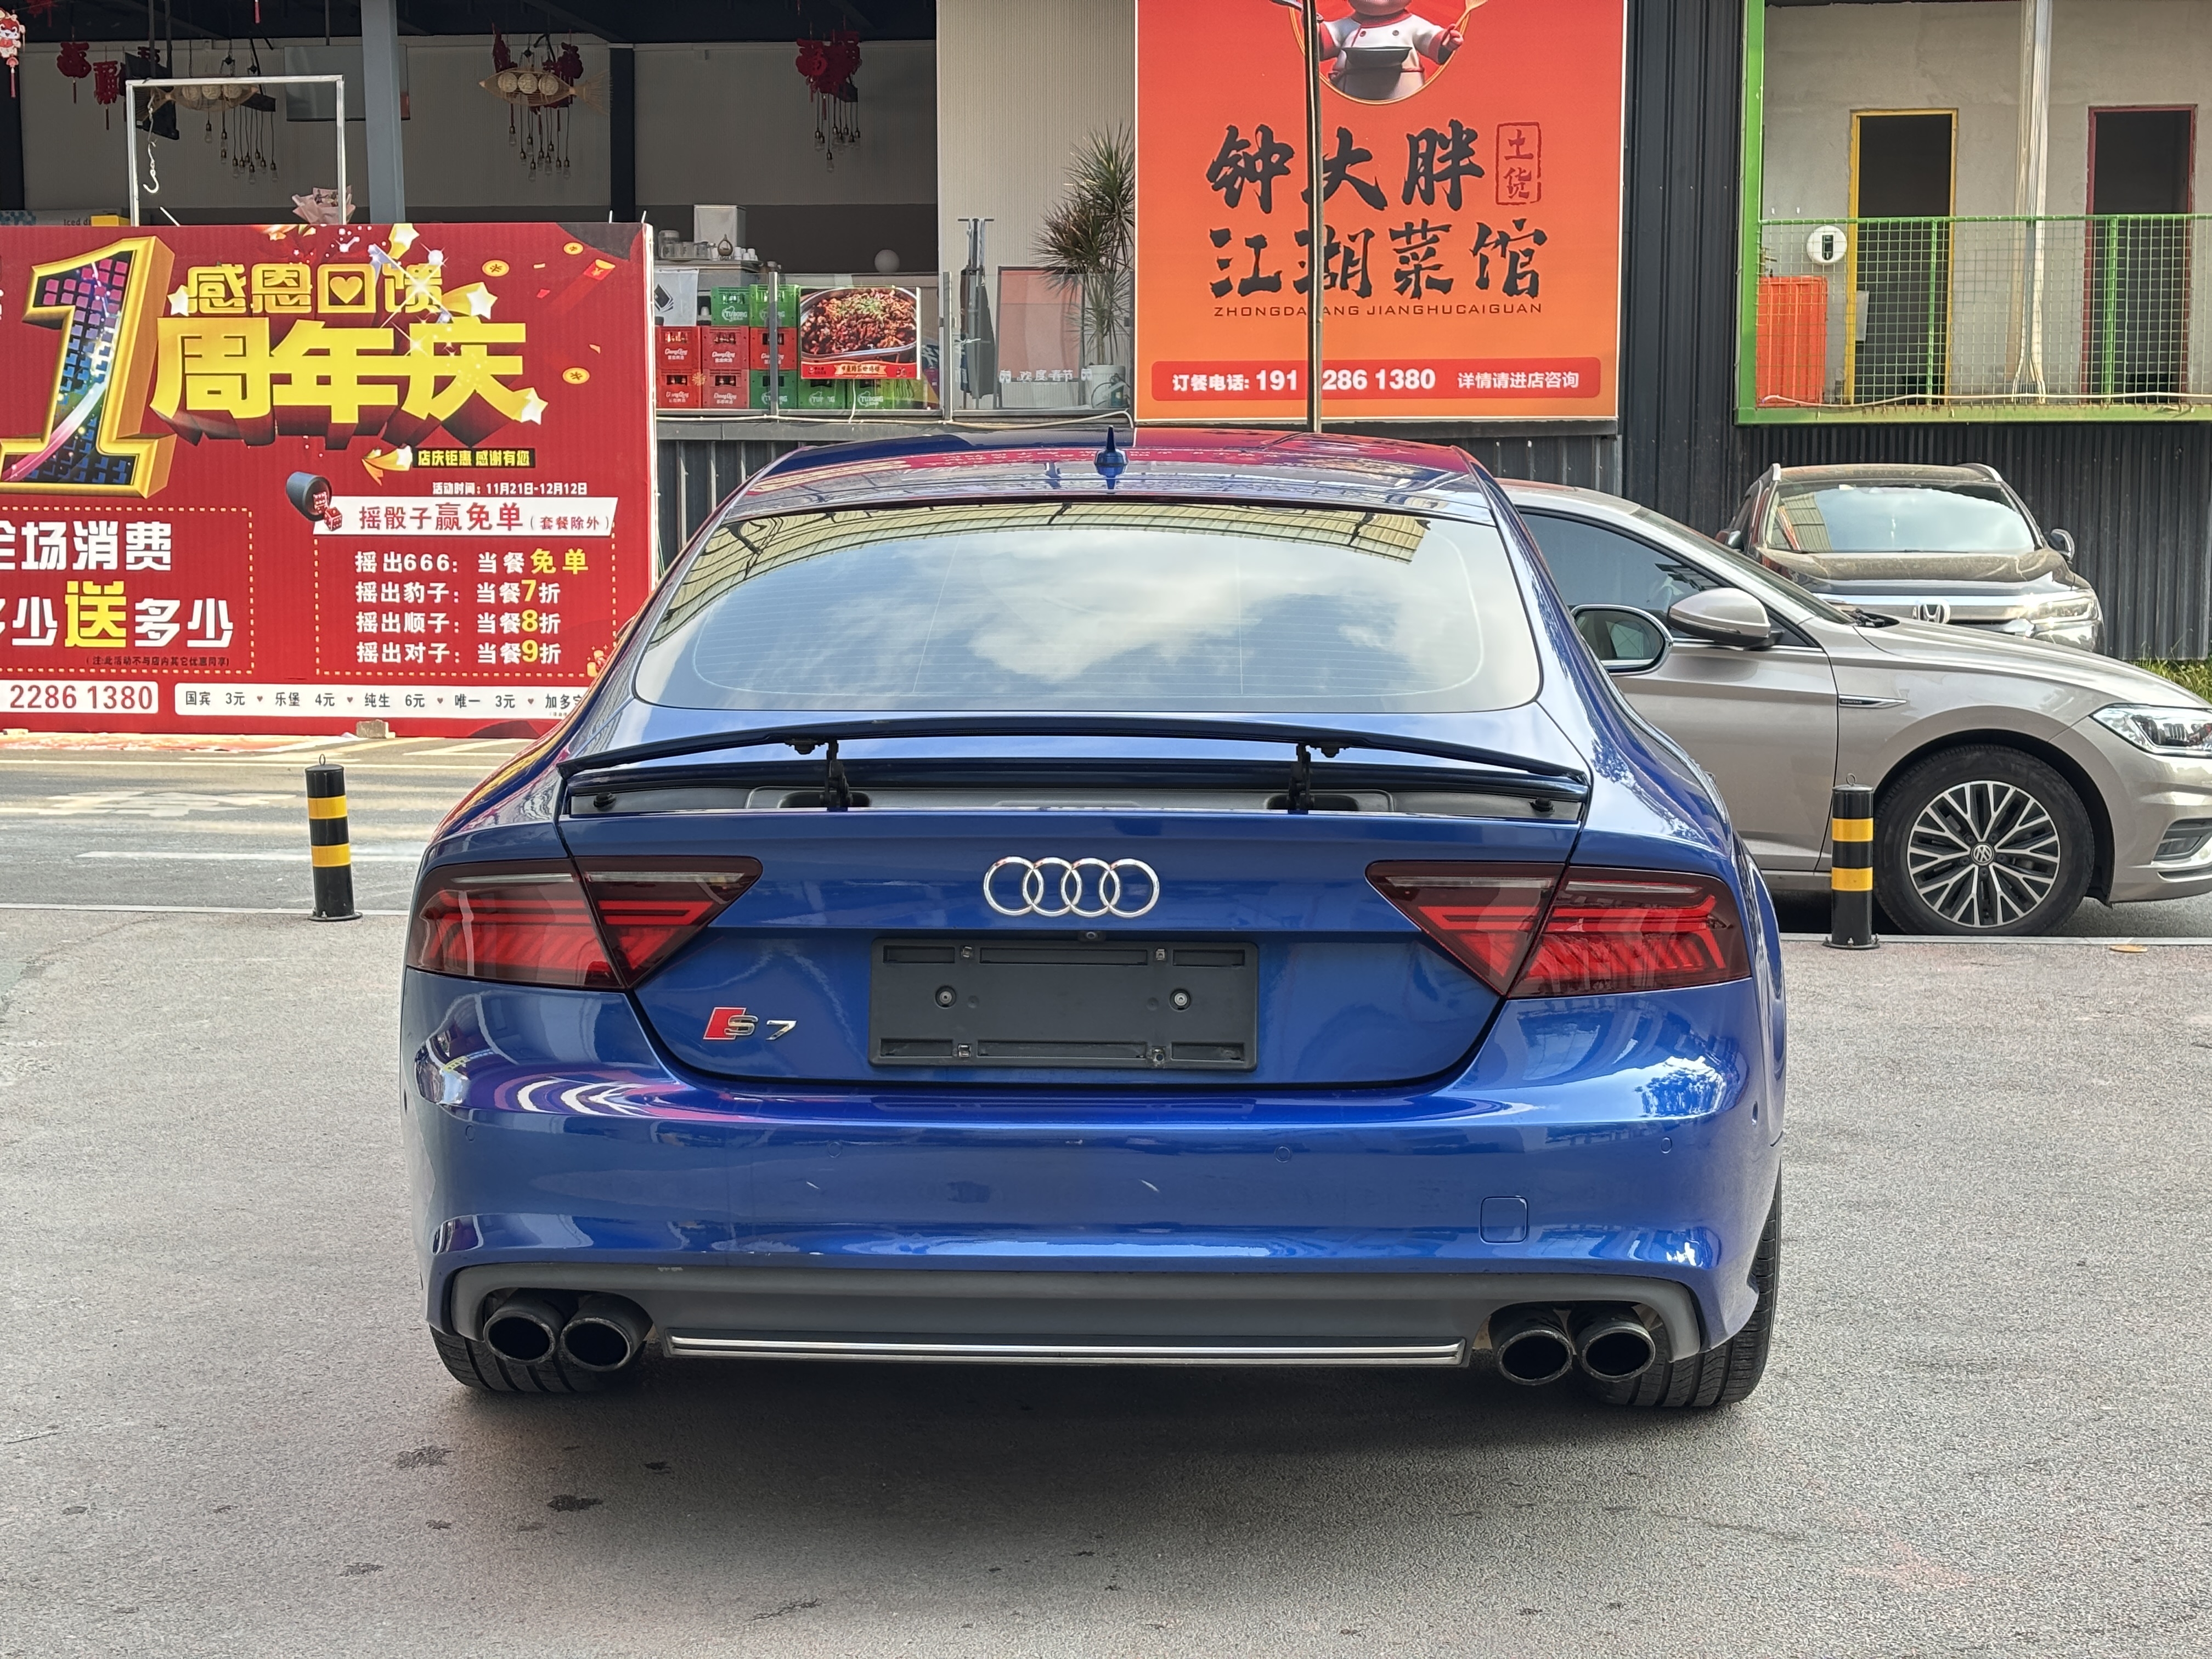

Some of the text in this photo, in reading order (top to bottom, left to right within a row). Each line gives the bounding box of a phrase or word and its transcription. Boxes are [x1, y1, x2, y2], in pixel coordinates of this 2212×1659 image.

[1206, 119, 1485, 214] 钟大胖
[1503, 128, 1534, 199] 土货
[1209, 219, 1548, 300] 江湖菜馆
[188, 263, 442, 313] 感恩回馈
[1214, 303, 1542, 317] ZHONGDAANG JIANGHUCAIGUAN
[0, 236, 176, 498] 1
[150, 317, 543, 424] 周年庆
[1256, 369, 1297, 390] 191
[1322, 369, 1367, 390] 286
[1375, 368, 1436, 390] 1380
[1457, 371, 1579, 389] 详情请进店咨询
[418, 450, 530, 466] 店庆钜惠 感谢有您
[359, 502, 523, 531] 摇骰子赢免单
[0, 580, 234, 648] 少送多少
[10, 685, 153, 710] 2286 1380
[185, 691, 211, 706] 国宾
[225, 692, 245, 706] 3元
[275, 692, 301, 707] 乐堡
[315, 693, 335, 707] 4元
[364, 693, 391, 708] 纯生
[405, 693, 425, 707] 6元
[455, 694, 481, 708] 唯一
[495, 694, 516, 708] 3元
